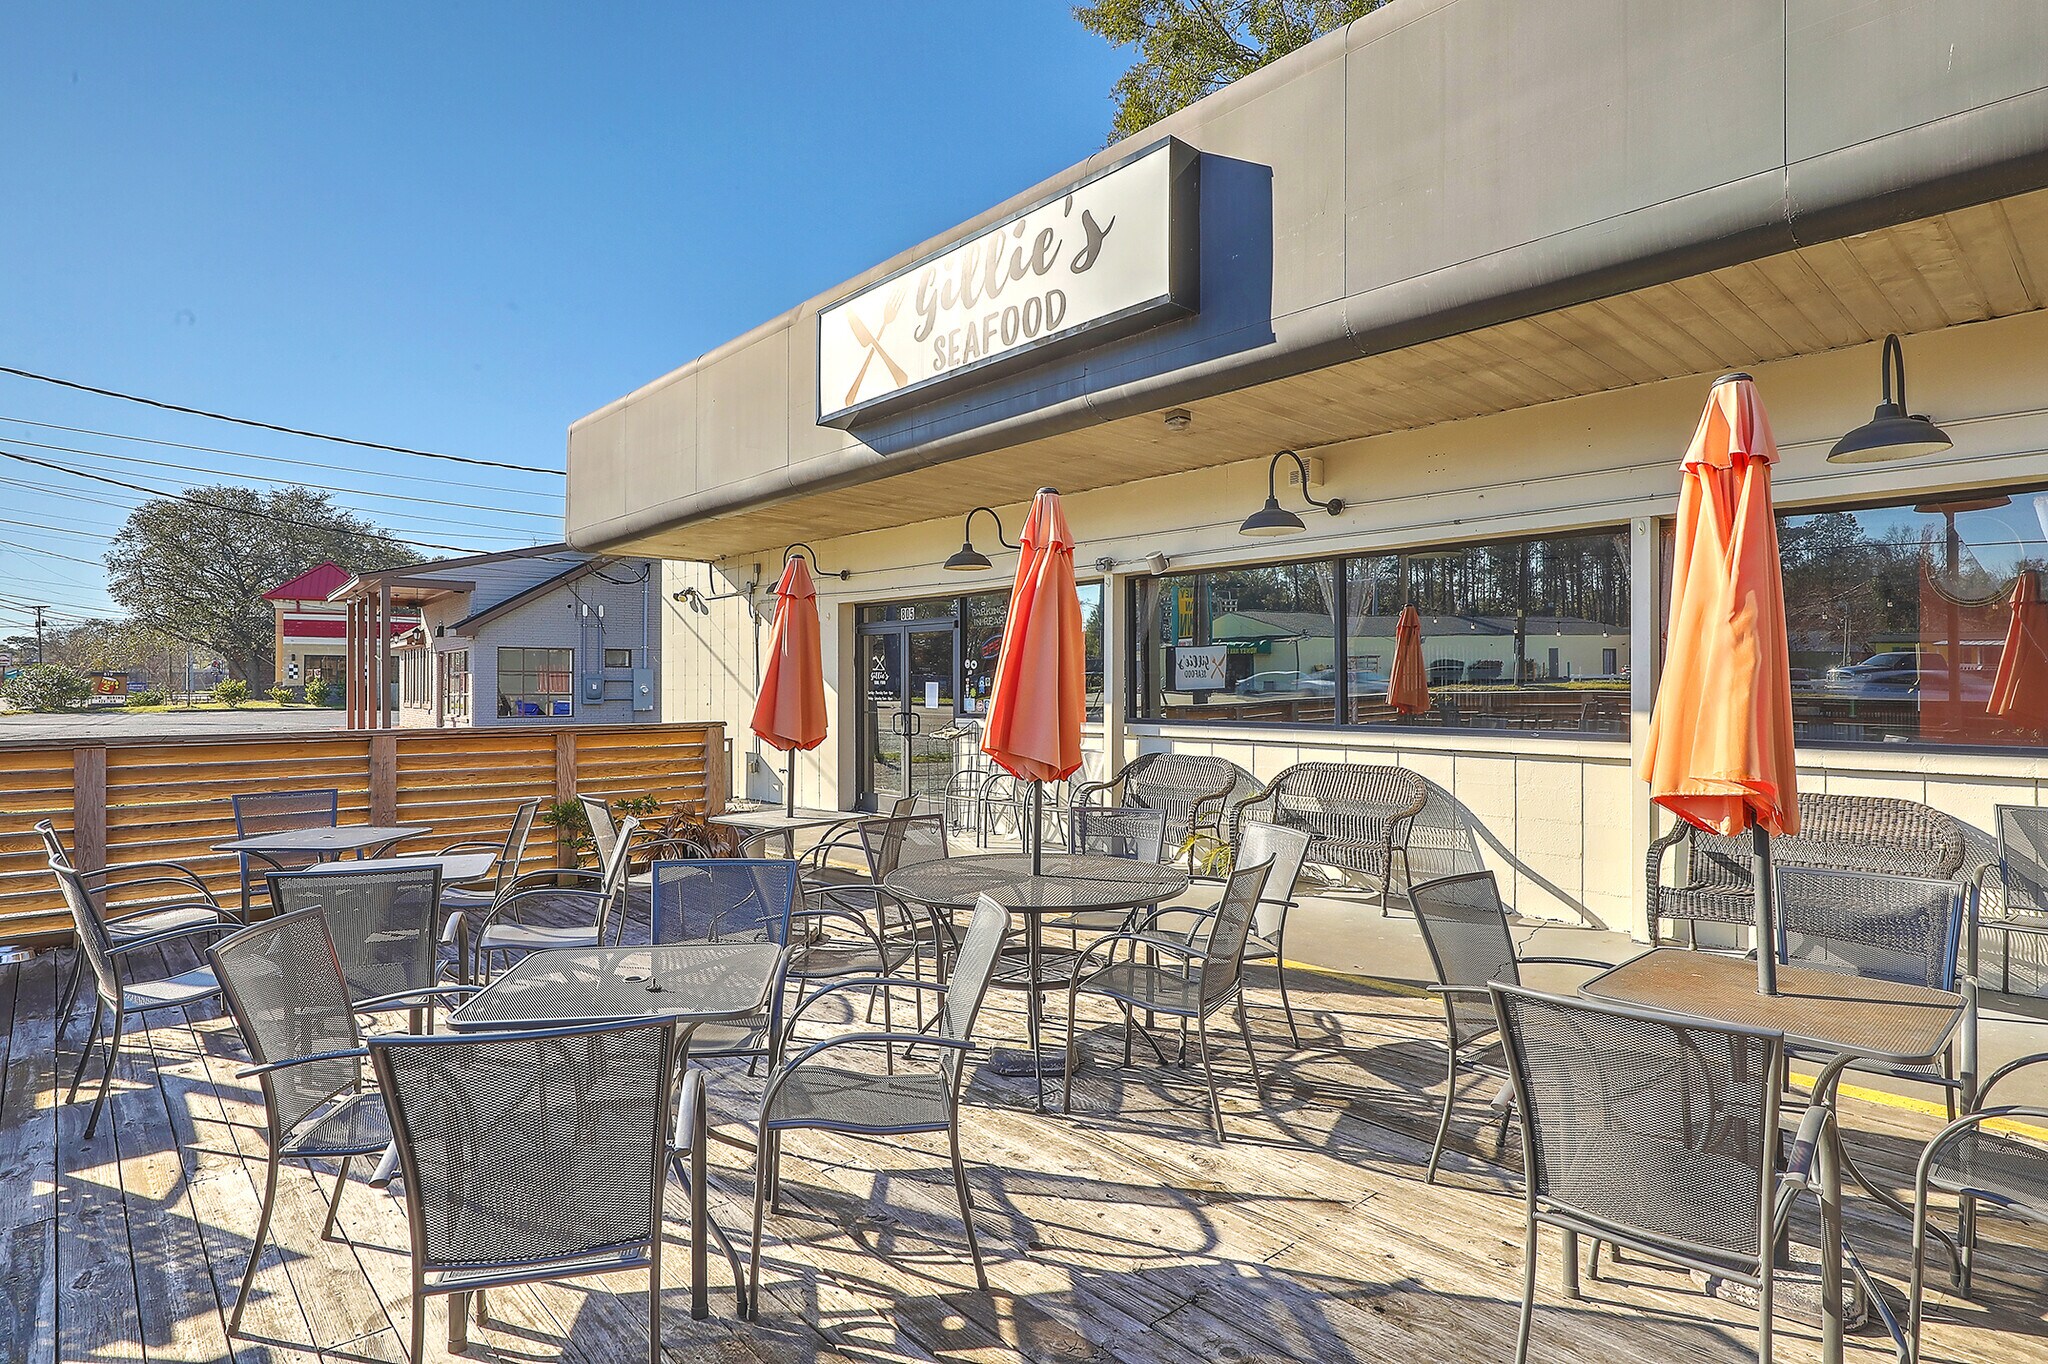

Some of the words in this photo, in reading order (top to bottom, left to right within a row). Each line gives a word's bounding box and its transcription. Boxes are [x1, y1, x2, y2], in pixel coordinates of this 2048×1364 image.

[933, 289, 1066, 371] SEAFOOD
[901, 607, 915, 620] 805
[972, 605, 1006, 617] PARKING
[973, 618, 982, 626] IN
[983, 616, 1005, 626] REAR
[981, 638, 1002, 657] OPE
